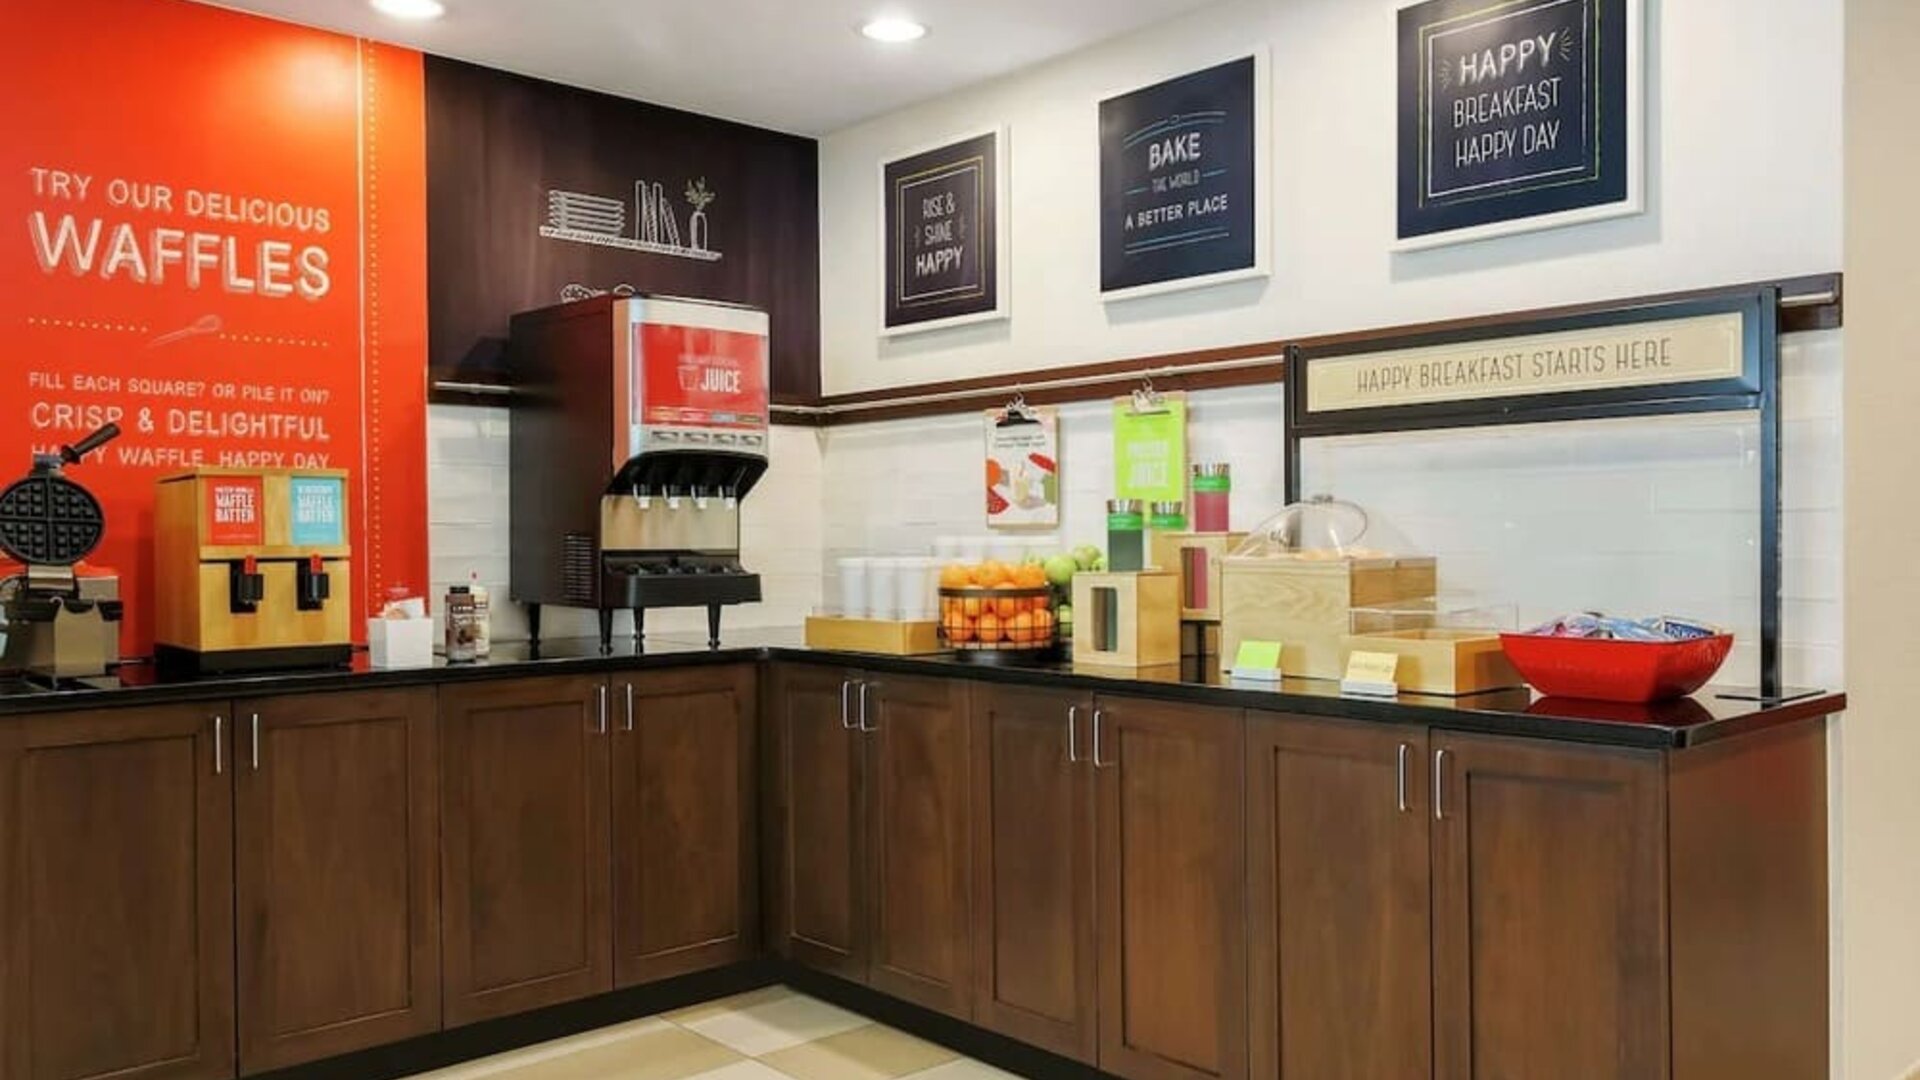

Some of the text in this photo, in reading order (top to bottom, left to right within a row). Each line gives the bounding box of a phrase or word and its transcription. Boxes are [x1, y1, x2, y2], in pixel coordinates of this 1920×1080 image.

[1459, 32, 1556, 85] HAPPY
[1454, 77, 1562, 128] BREAKFAST
[1149, 132, 1200, 171] BAKE
[1455, 119, 1560, 168] HAPPY DAY
[31, 167, 331, 233] TRY OUR DELICIOUS
[1125, 194, 1228, 231] A BETTER PLACE
[28, 210, 331, 302] WAFFLES
[916, 245, 963, 276] HAPPY
[700, 368, 741, 394] JUICE
[1356, 338, 1672, 394] HAPPY BREAKFAST STARTS HERE
[29, 371, 330, 405] FILL EACH SQUARE? OR PILE IT ON?
[31, 401, 331, 441] CRISP & DELIGHTFUL
[219, 450, 285, 470] HAPPY
[293, 452, 330, 470] DAY
[215, 493, 254, 508] WAFFLE
[215, 508, 254, 523] BATTER
